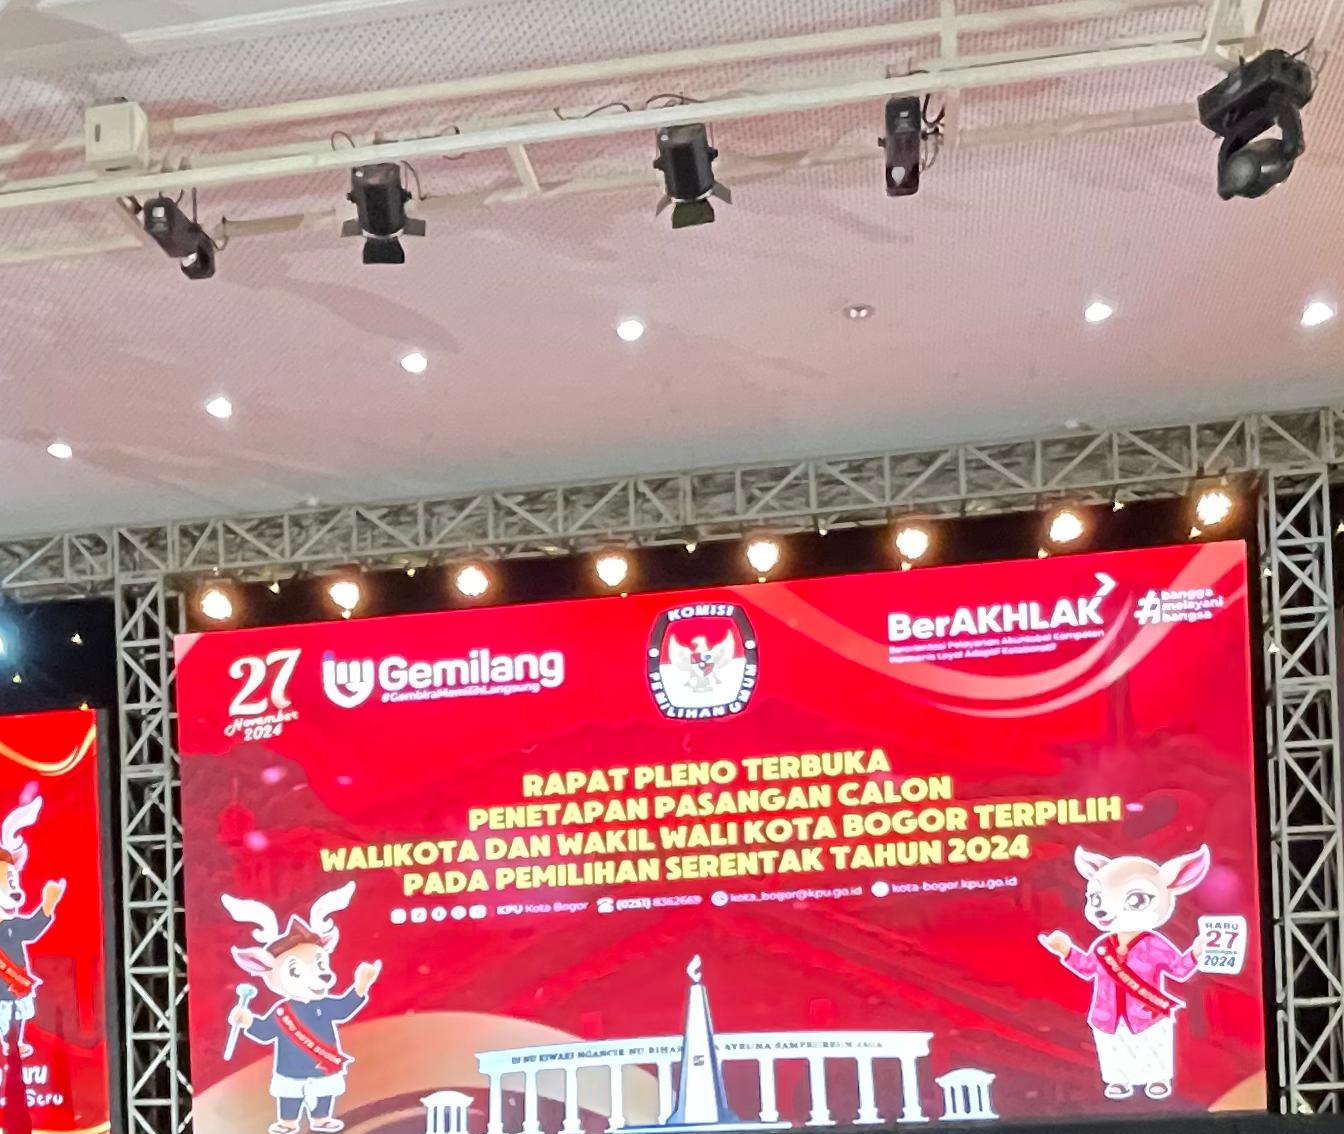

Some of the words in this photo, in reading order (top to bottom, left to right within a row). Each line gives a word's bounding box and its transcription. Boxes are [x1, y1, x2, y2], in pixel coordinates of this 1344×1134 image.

[1160, 588, 1214, 602] bangga
[1161, 595, 1224, 611] melayani
[667, 604, 735, 622] KOMISI
[887, 596, 1105, 642] BerAKHLAK
[1162, 610, 1213, 623] bangsa
[378, 648, 565, 691] Gemilang
[228, 648, 302, 717] 27
[224, 710, 299, 737] November
[244, 724, 283, 741] 2024
[522, 767, 629, 798] RAPAT
[634, 758, 737, 791] PLENO
[742, 747, 891, 782] TERBUKA
[468, 798, 649, 832] PENETAPAN
[655, 784, 832, 821] PASANGAN
[837, 775, 953, 806] CALON
[320, 840, 479, 873] WALIKOTA
[484, 834, 551, 862] DAN
[557, 828, 655, 857] WAKIL
[660, 820, 739, 849] WALI
[744, 815, 837, 845] KOTA
[842, 806, 968, 838] BOGOR
[973, 795, 1123, 830] TERPILIH
[403, 868, 489, 897] PADA
[495, 857, 660, 891] PEMILIHAN
[665, 846, 825, 881] SERENTAK
[829, 840, 943, 871] TAHUN
[947, 833, 1031, 863] 2024
[497, 903, 524, 916] KPU
[553, 901, 590, 913] Bogor
[1206, 930, 1239, 949] 27
[1203, 954, 1236, 968] 2024
[25, 1088, 64, 1107] Seru
